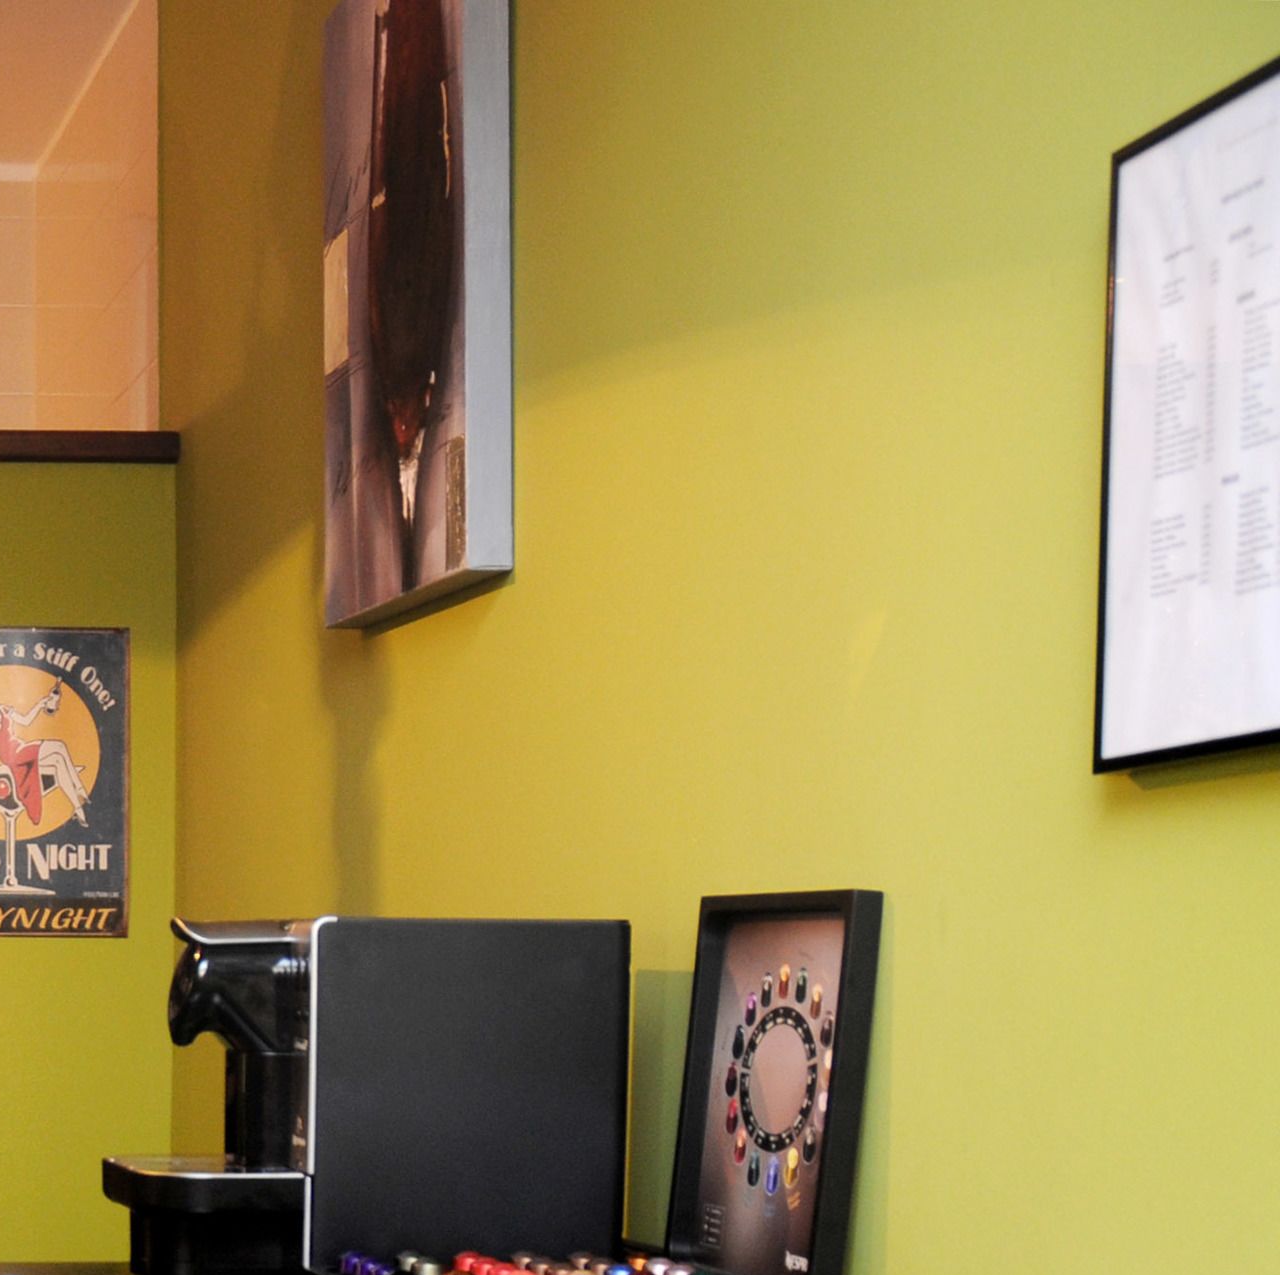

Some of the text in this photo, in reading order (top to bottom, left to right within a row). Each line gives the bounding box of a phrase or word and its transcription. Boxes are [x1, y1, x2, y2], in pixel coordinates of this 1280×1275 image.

[13, 644, 26, 658] a
[32, 641, 79, 671] Stiff
[80, 668, 117, 713] One!
[26, 843, 112, 881] NIGHT
